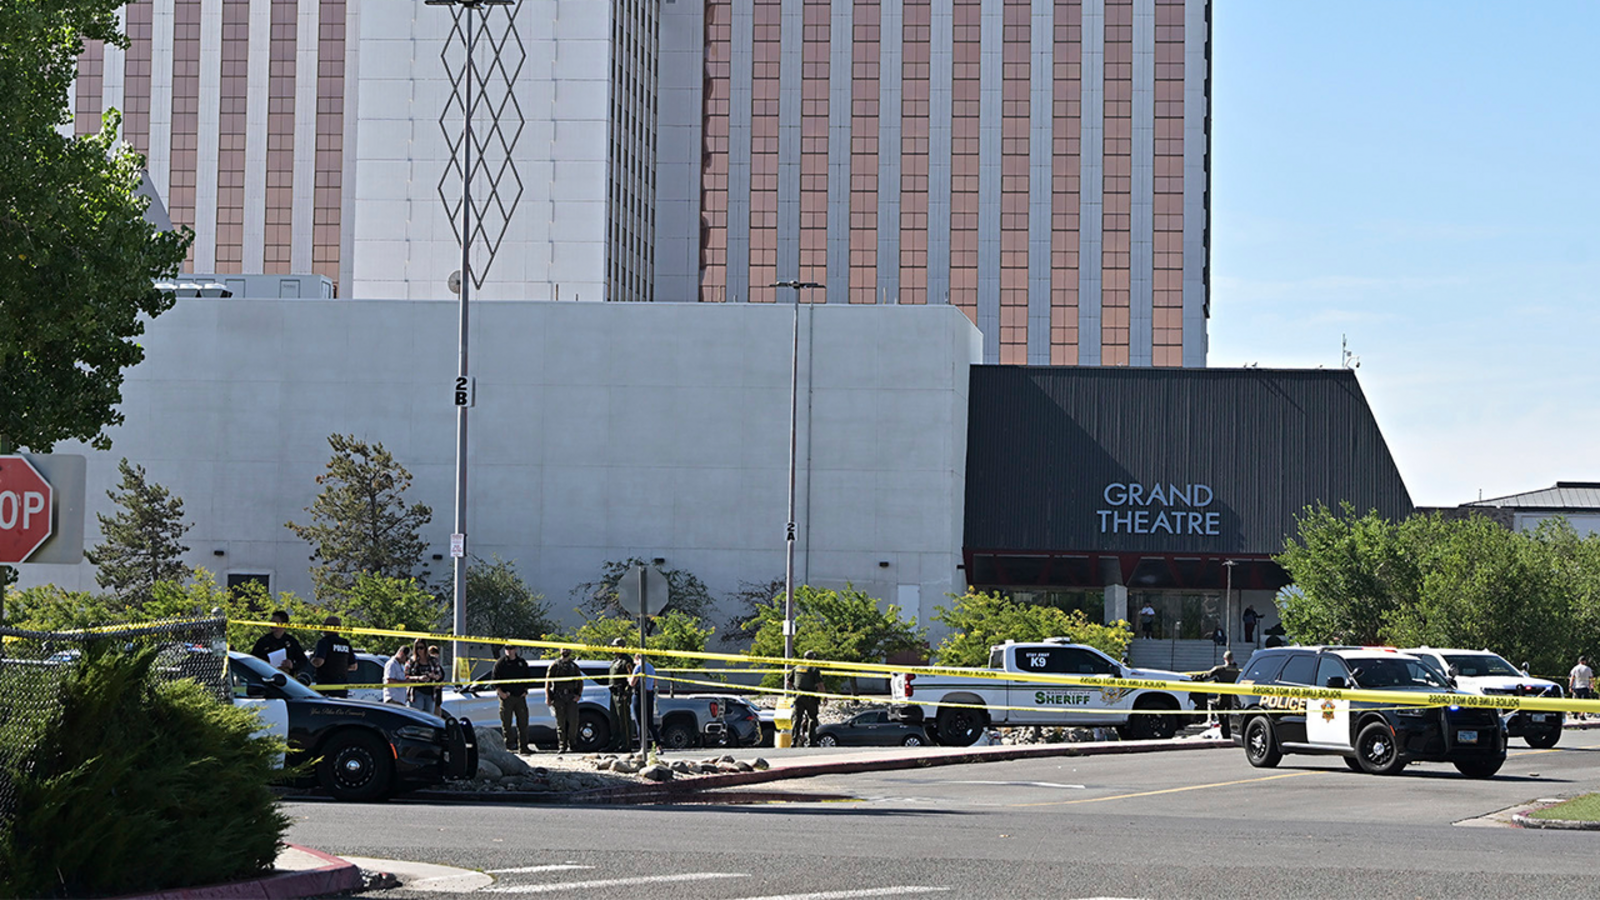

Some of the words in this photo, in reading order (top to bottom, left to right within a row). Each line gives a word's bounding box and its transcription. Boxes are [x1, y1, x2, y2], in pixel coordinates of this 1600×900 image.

[455, 377, 468, 405] 2B
[1103, 482, 1214, 507] GRAND
[0, 490, 45, 530] OP
[1096, 510, 1220, 535] THEATRE
[333, 644, 350, 654] POLICE
[1030, 657, 1047, 667] K9
[1035, 691, 1090, 705] SHERIFF
[1259, 695, 1307, 711] POLICE
